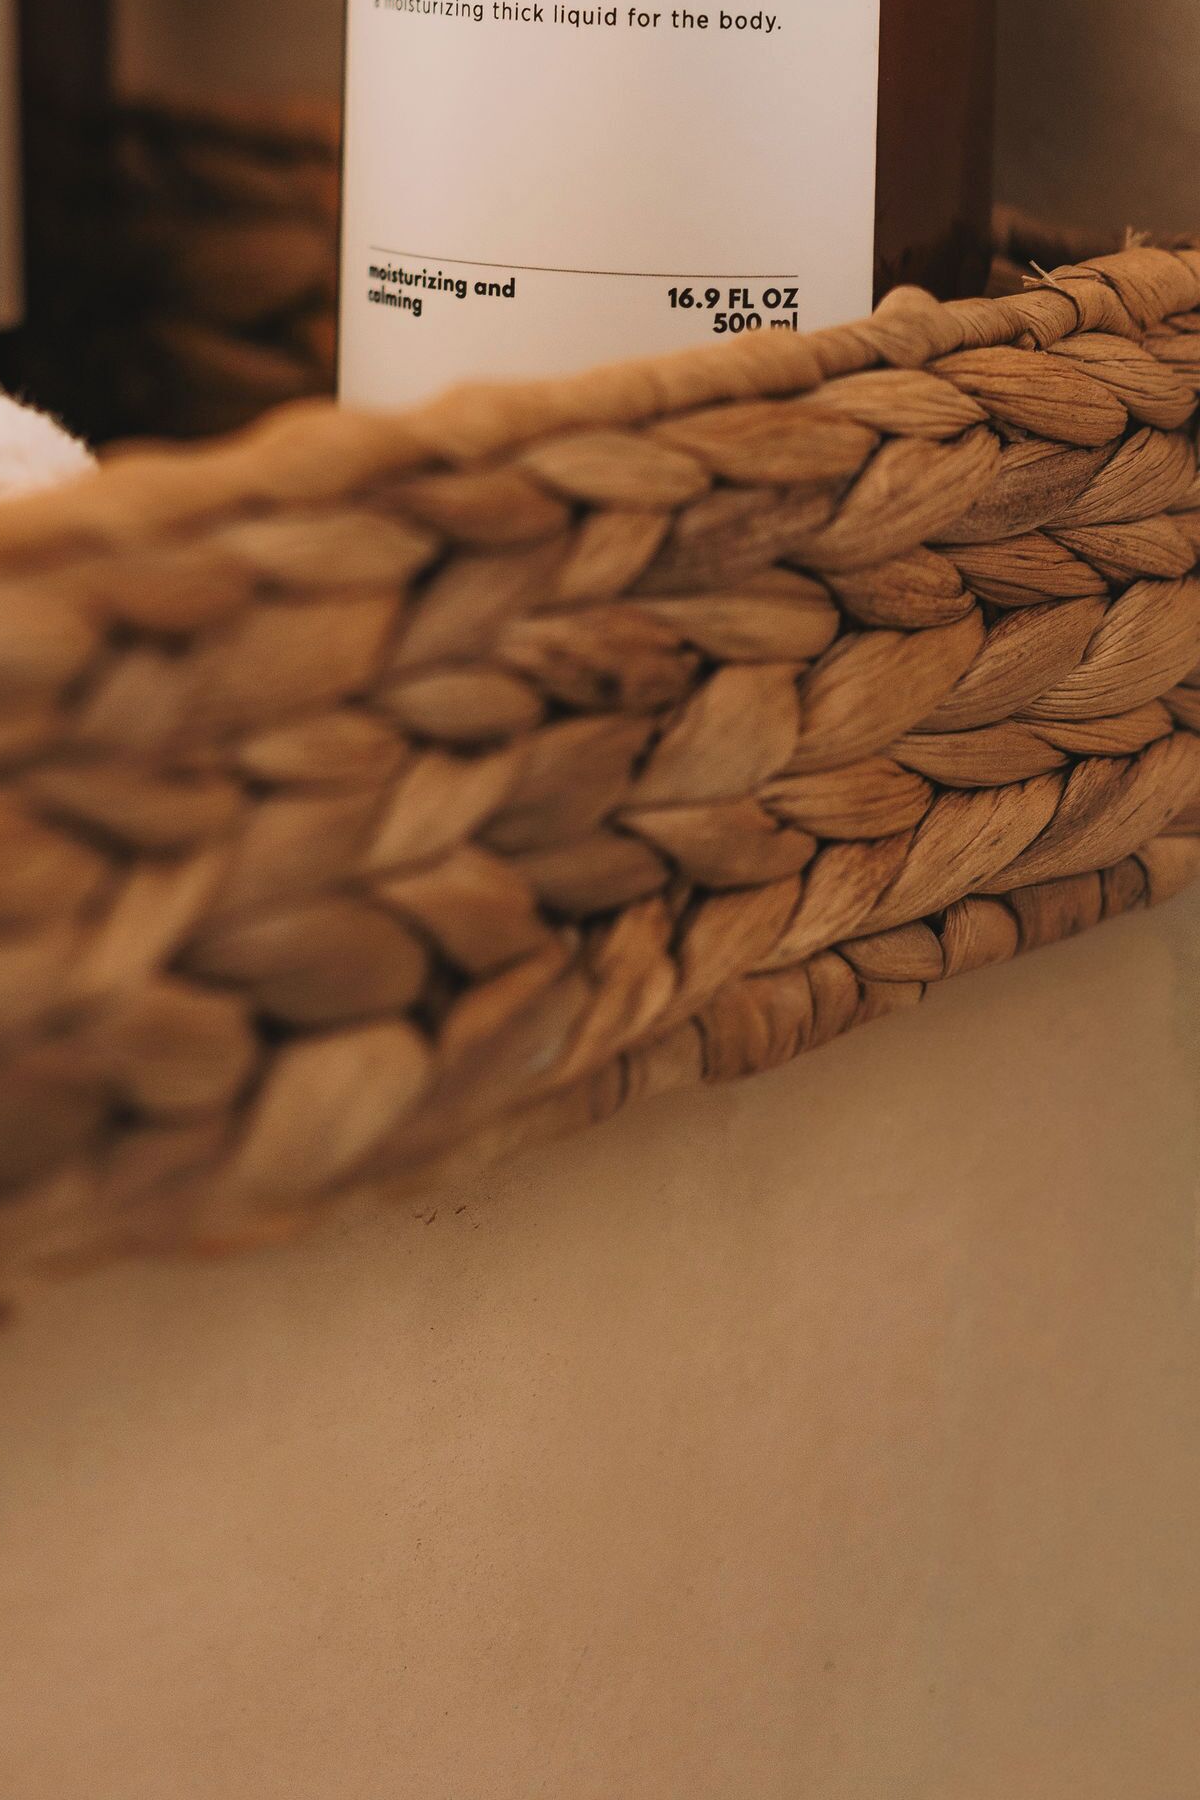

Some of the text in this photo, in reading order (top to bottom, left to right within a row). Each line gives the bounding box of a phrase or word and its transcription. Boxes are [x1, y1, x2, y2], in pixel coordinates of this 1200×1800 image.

[493, 1, 544, 23] thick
[553, 4, 618, 28] liquid
[628, 8, 661, 28] for
[671, 9, 709, 29] the
[719, 10, 782, 34] body.
[368, 264, 516, 299] moisturizing and
[367, 286, 423, 317] calming
[668, 287, 799, 309] 16.9 FL OZ
[712, 311, 798, 333] 500 ml
